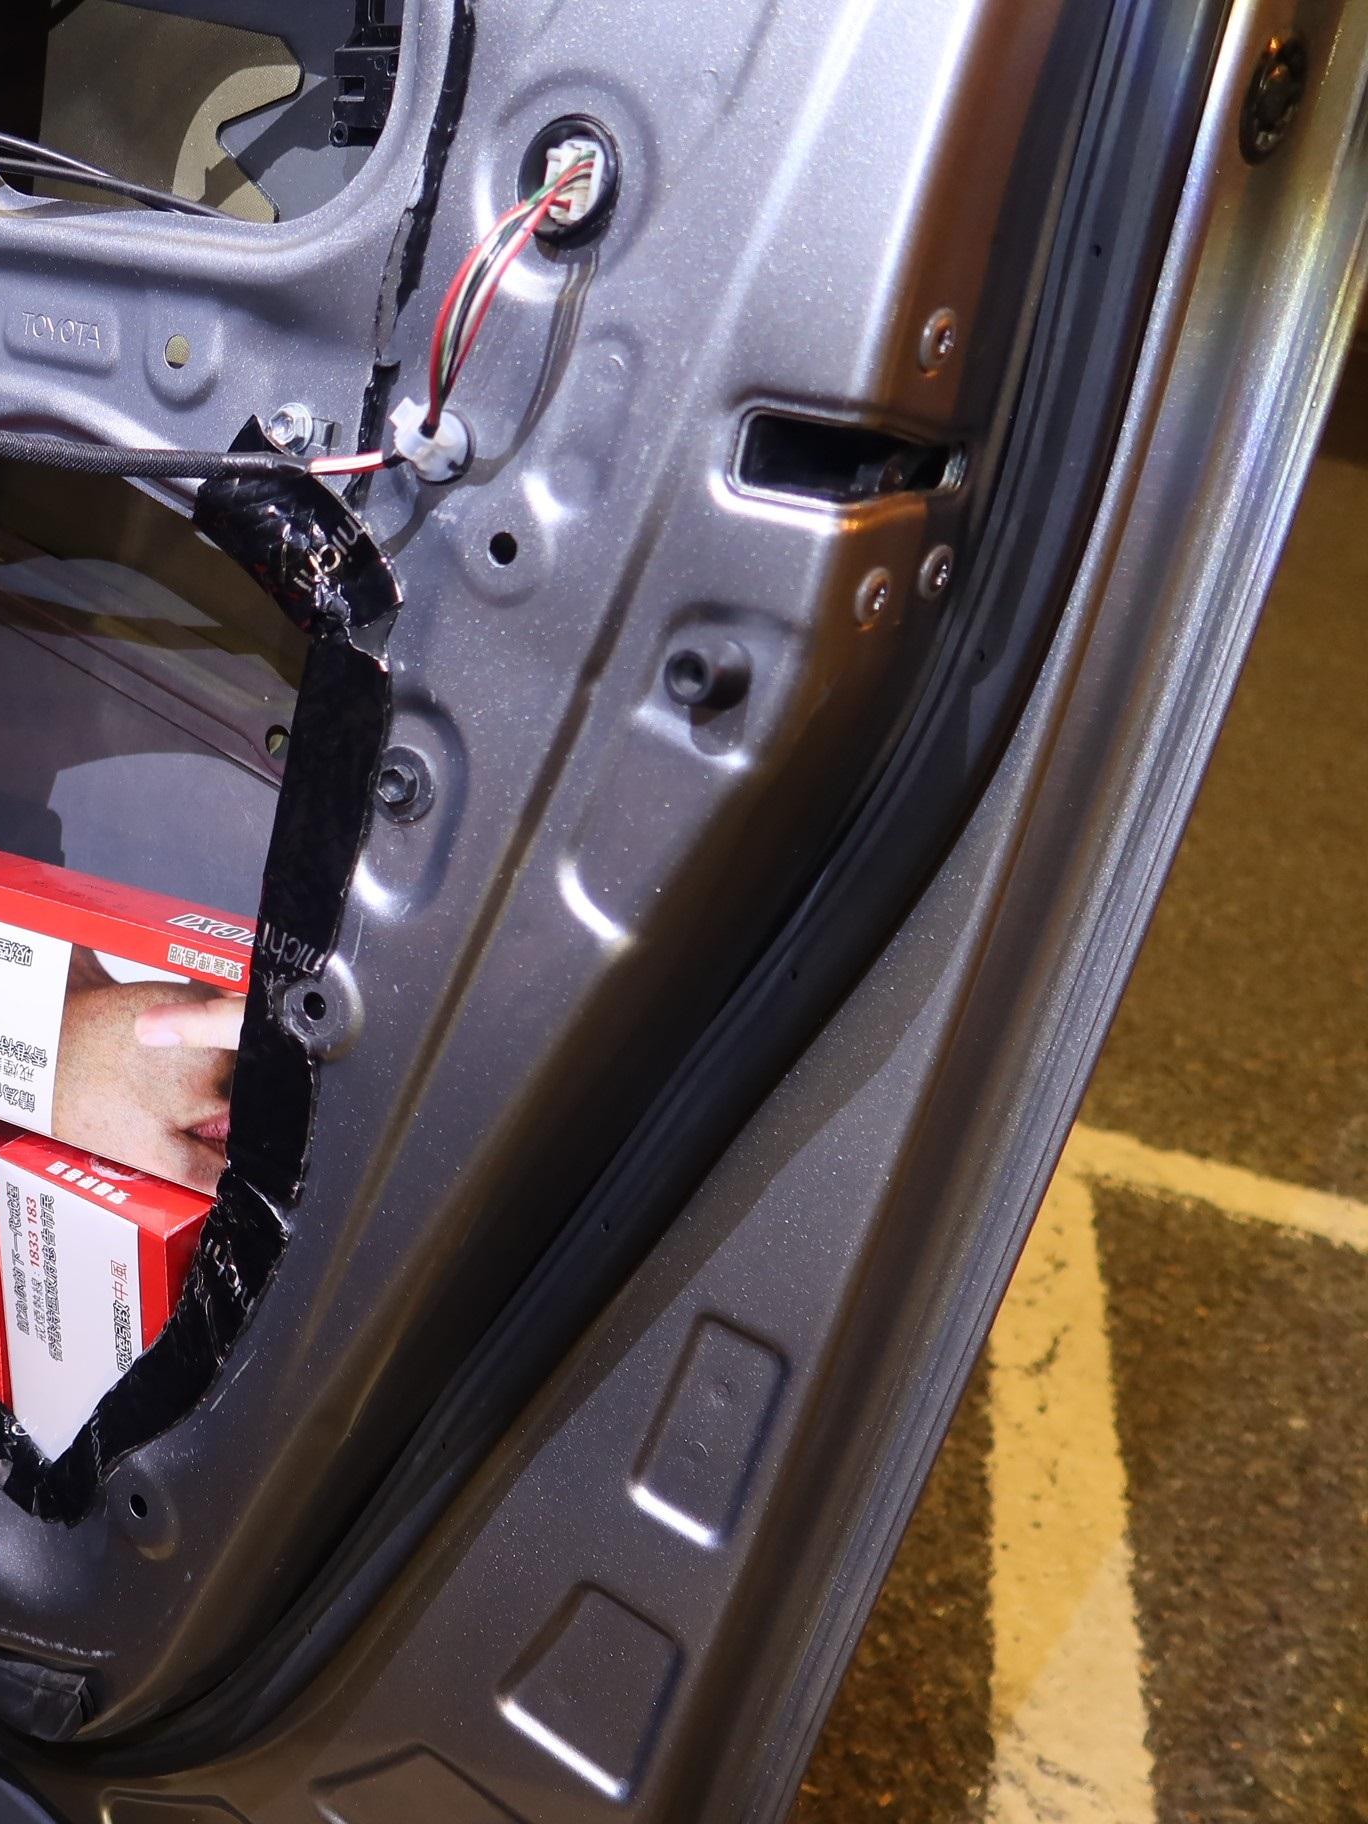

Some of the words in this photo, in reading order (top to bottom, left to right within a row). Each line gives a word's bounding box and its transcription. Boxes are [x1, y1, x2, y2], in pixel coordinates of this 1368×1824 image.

[22, 311, 100, 350] TOYOTA
[26, 1196, 38, 1225] 183
[28, 1230, 40, 1268] 1833
